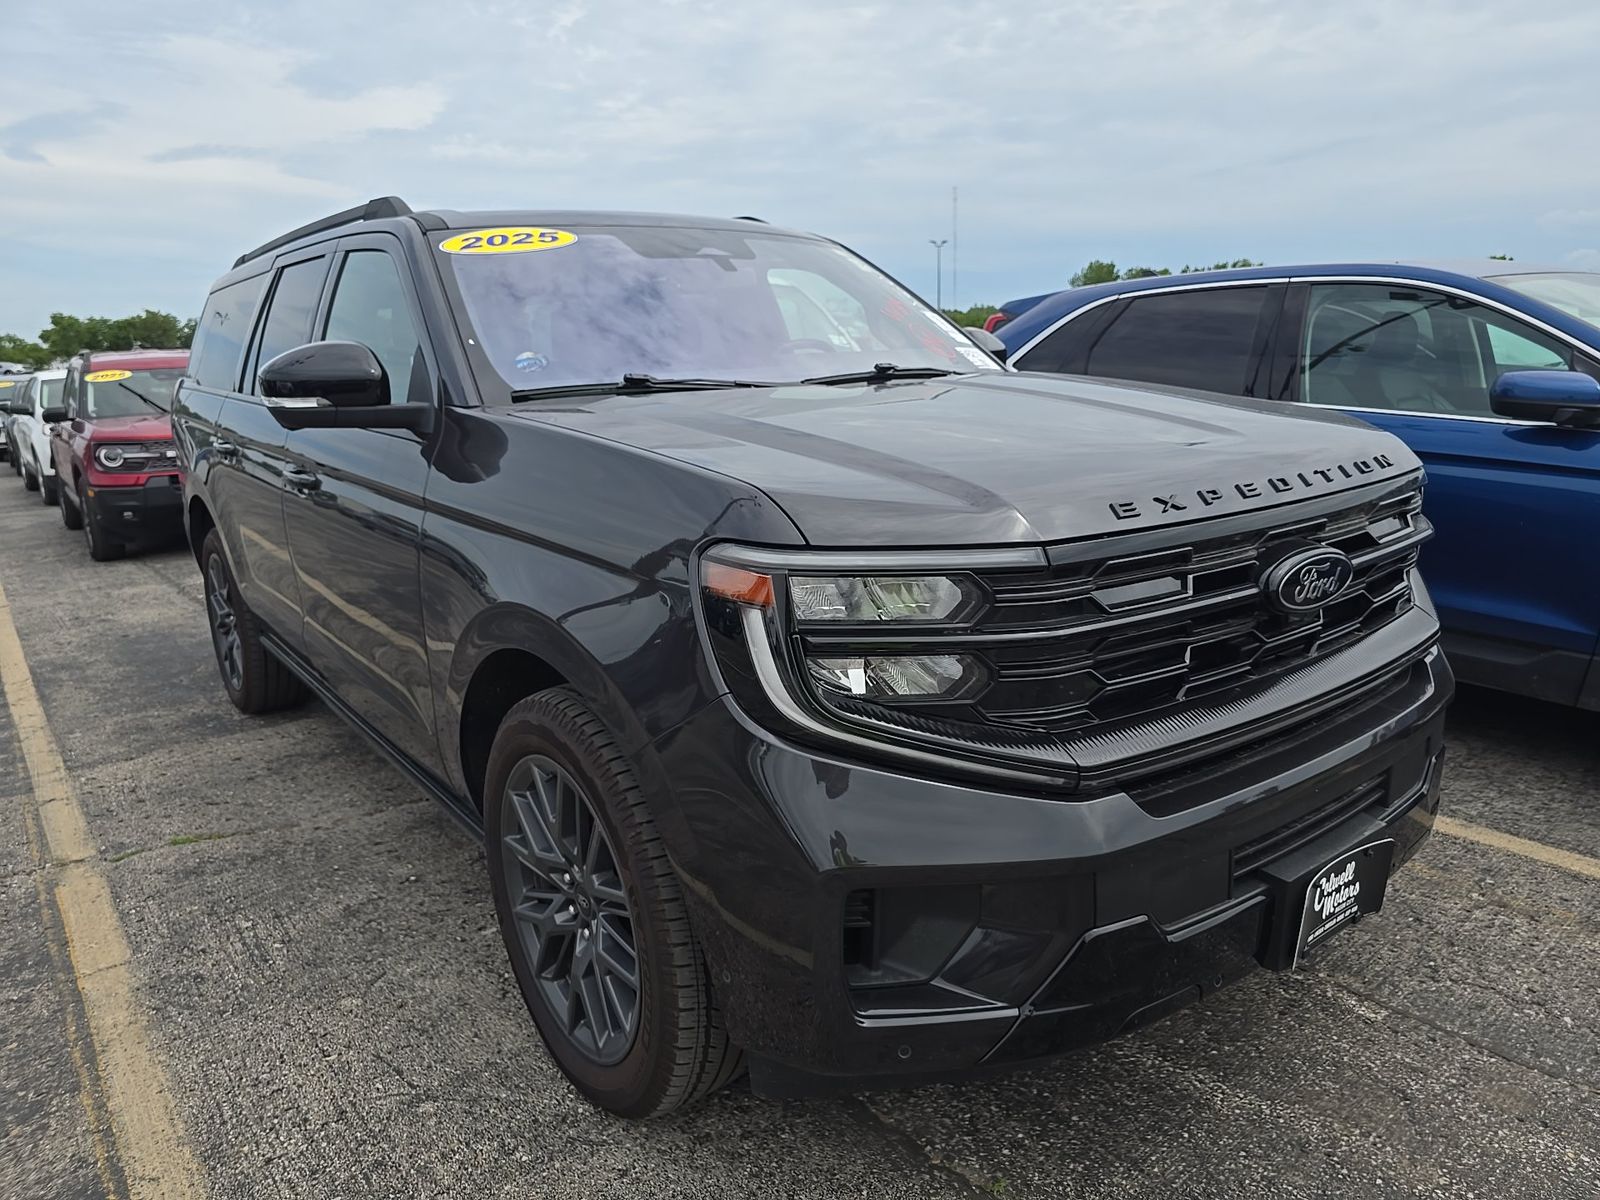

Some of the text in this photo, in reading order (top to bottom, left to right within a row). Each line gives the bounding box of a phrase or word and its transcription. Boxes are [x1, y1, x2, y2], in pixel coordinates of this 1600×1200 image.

[459, 231, 560, 251] 2025
[1108, 454, 1395, 520] EXPEDITION
[1294, 561, 1342, 603] Ford
[1322, 881, 1360, 920] Motors
